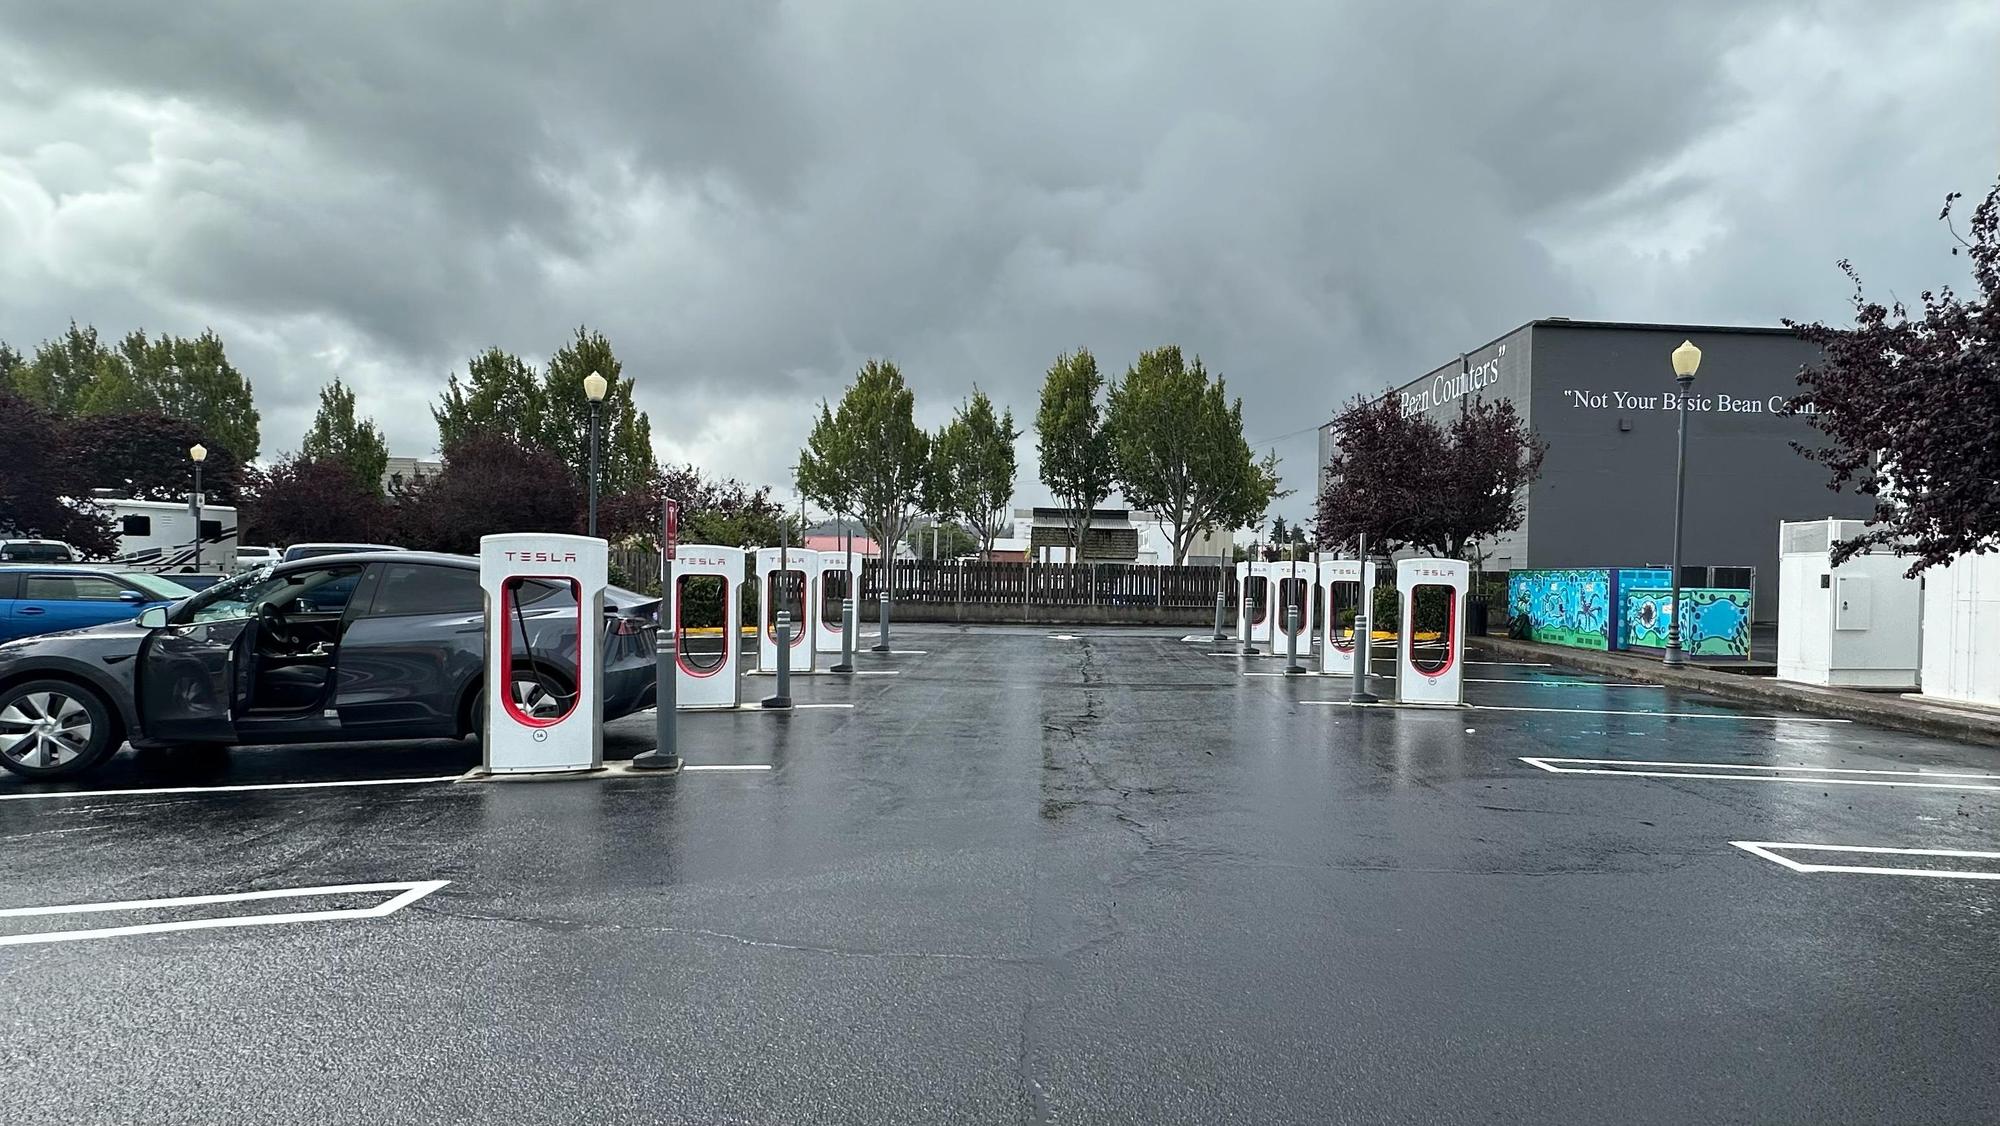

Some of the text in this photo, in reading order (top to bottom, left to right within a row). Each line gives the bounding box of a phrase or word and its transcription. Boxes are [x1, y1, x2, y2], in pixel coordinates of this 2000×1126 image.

[1400, 390, 1430, 419] Bean
[1612, 391, 1658, 410] Your
[1717, 394, 1763, 413] Bean
[504, 552, 576, 562] TESLA
[678, 557, 726, 565] TESLA
[1414, 569, 1455, 577] TESLA
